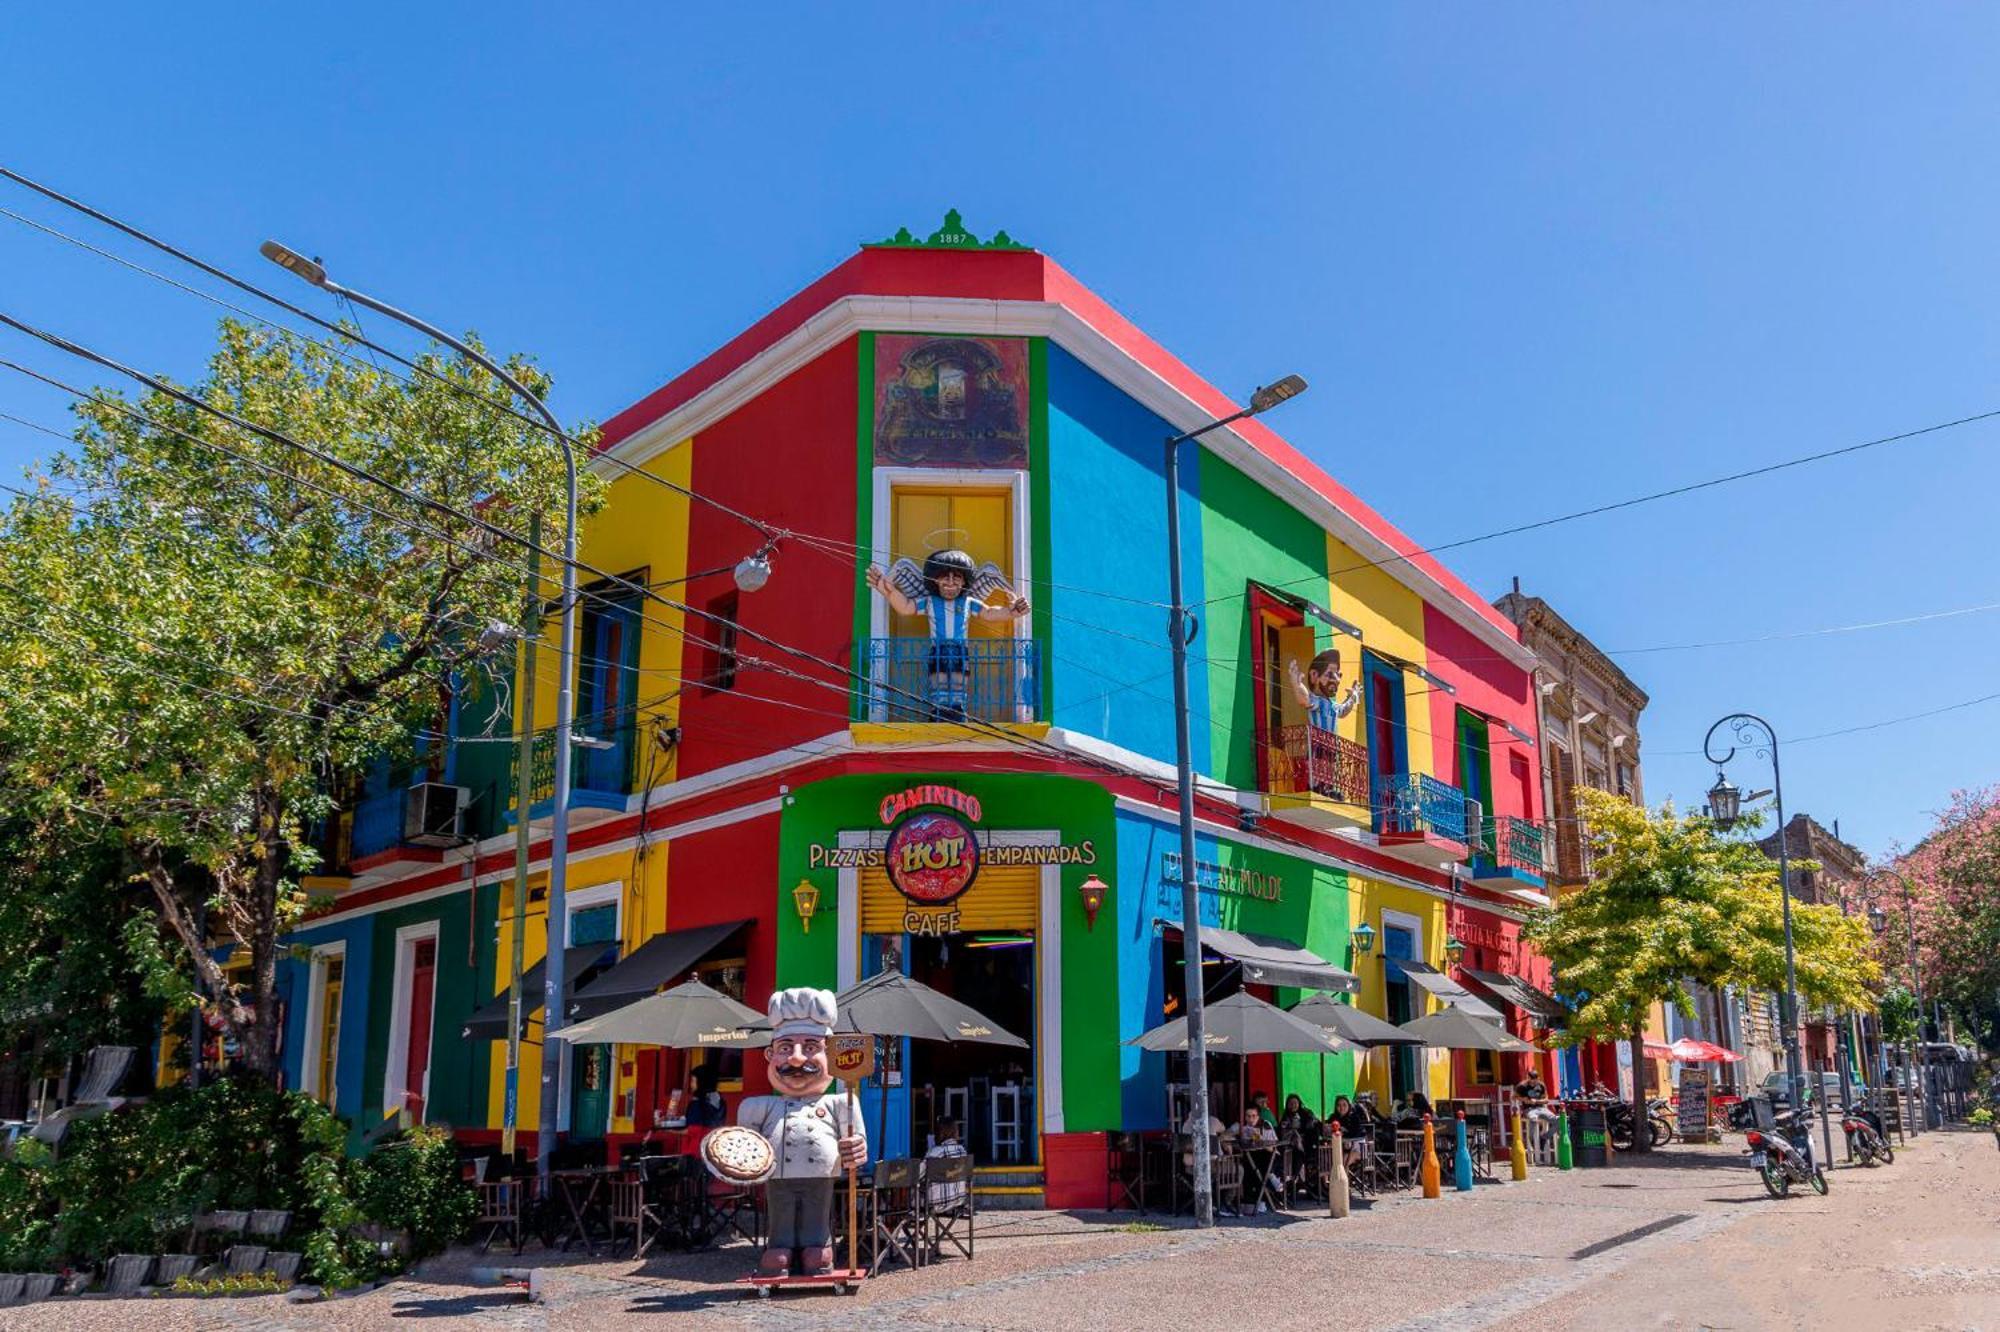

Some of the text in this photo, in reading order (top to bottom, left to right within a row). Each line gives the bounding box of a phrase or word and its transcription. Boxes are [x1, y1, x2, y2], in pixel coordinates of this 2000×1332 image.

[940, 233, 967, 244] 1887
[880, 784, 983, 825] CAMINITO
[986, 840, 1096, 865] EMPANADAS
[904, 911, 961, 937] CAFE
[698, 1030, 749, 1043] Imperial
